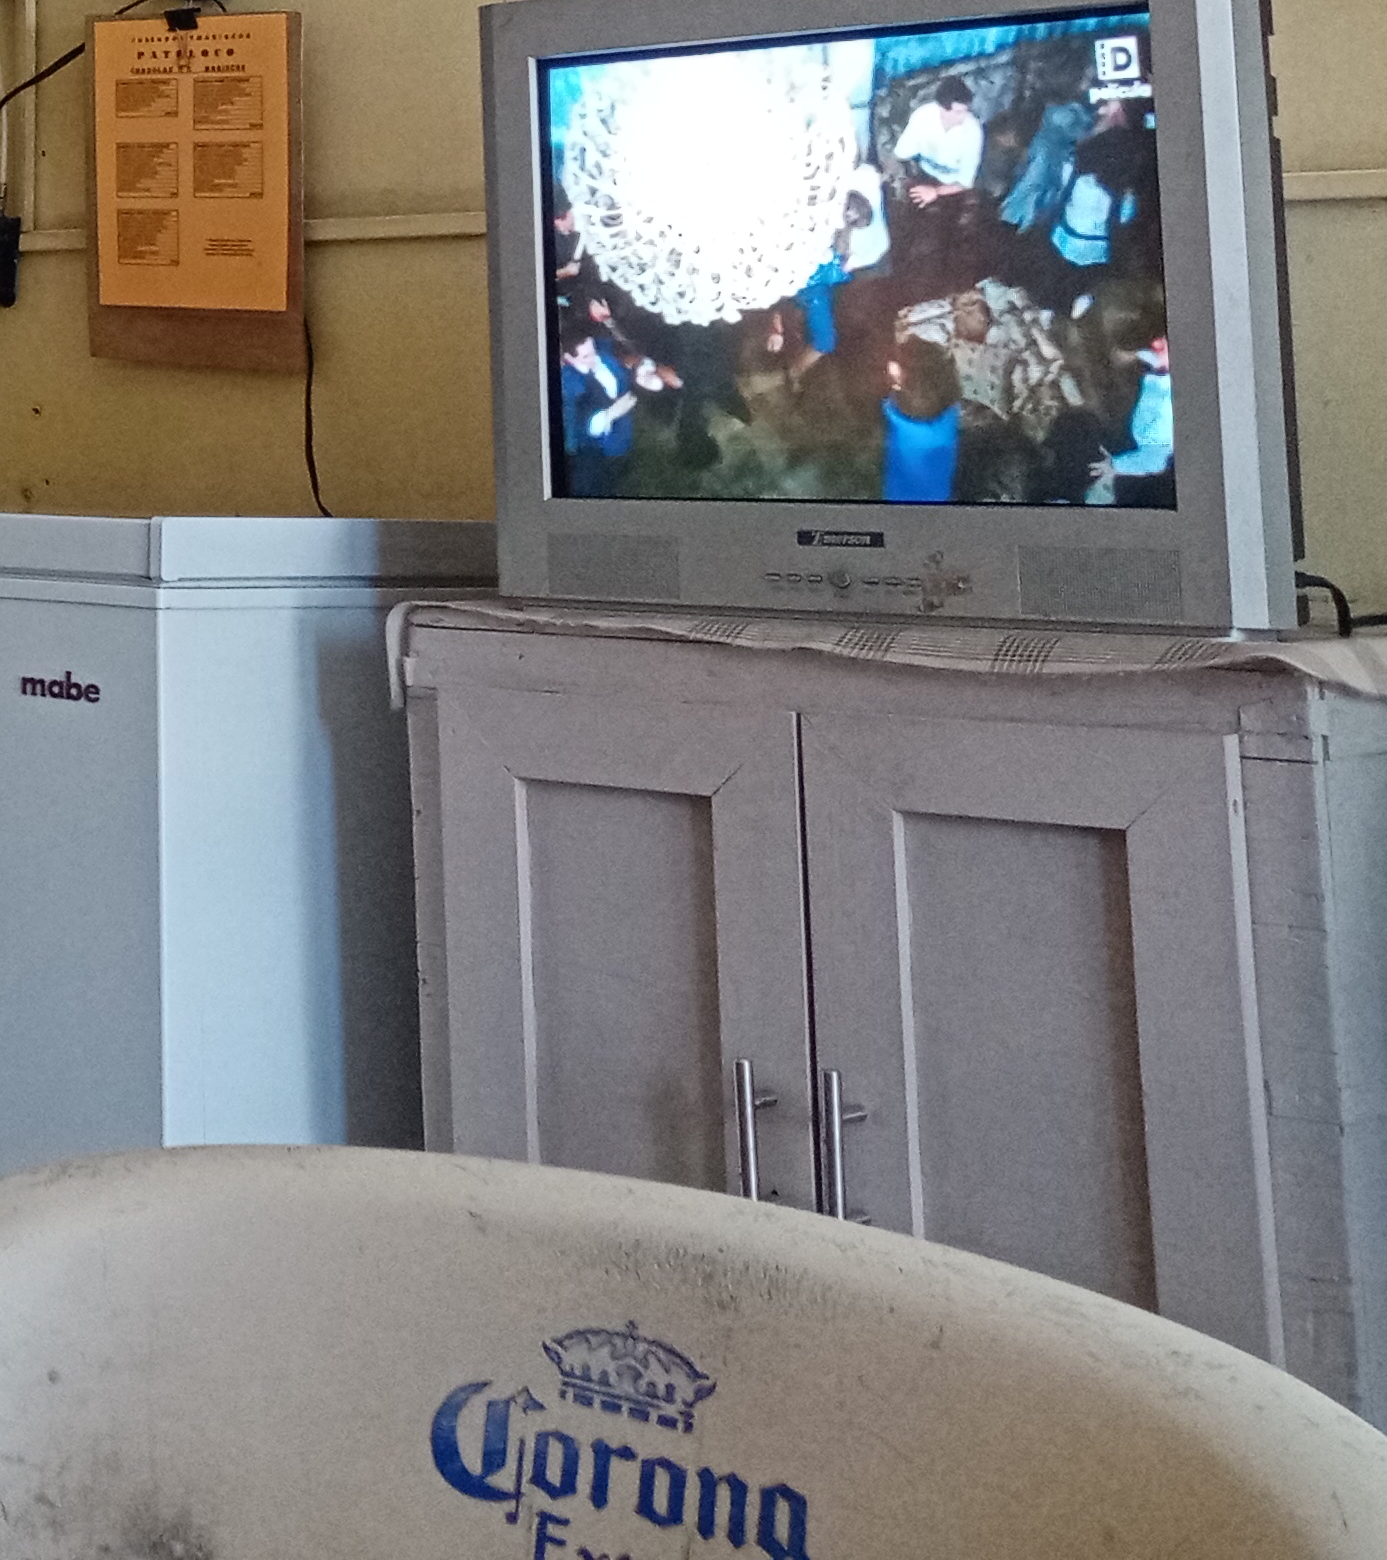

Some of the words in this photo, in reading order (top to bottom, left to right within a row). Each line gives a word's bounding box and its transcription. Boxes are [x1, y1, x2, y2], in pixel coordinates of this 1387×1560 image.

[1111, 46, 1132, 72] D
[21, 671, 100, 703] mabe
[430, 1380, 811, 1560] Corona
